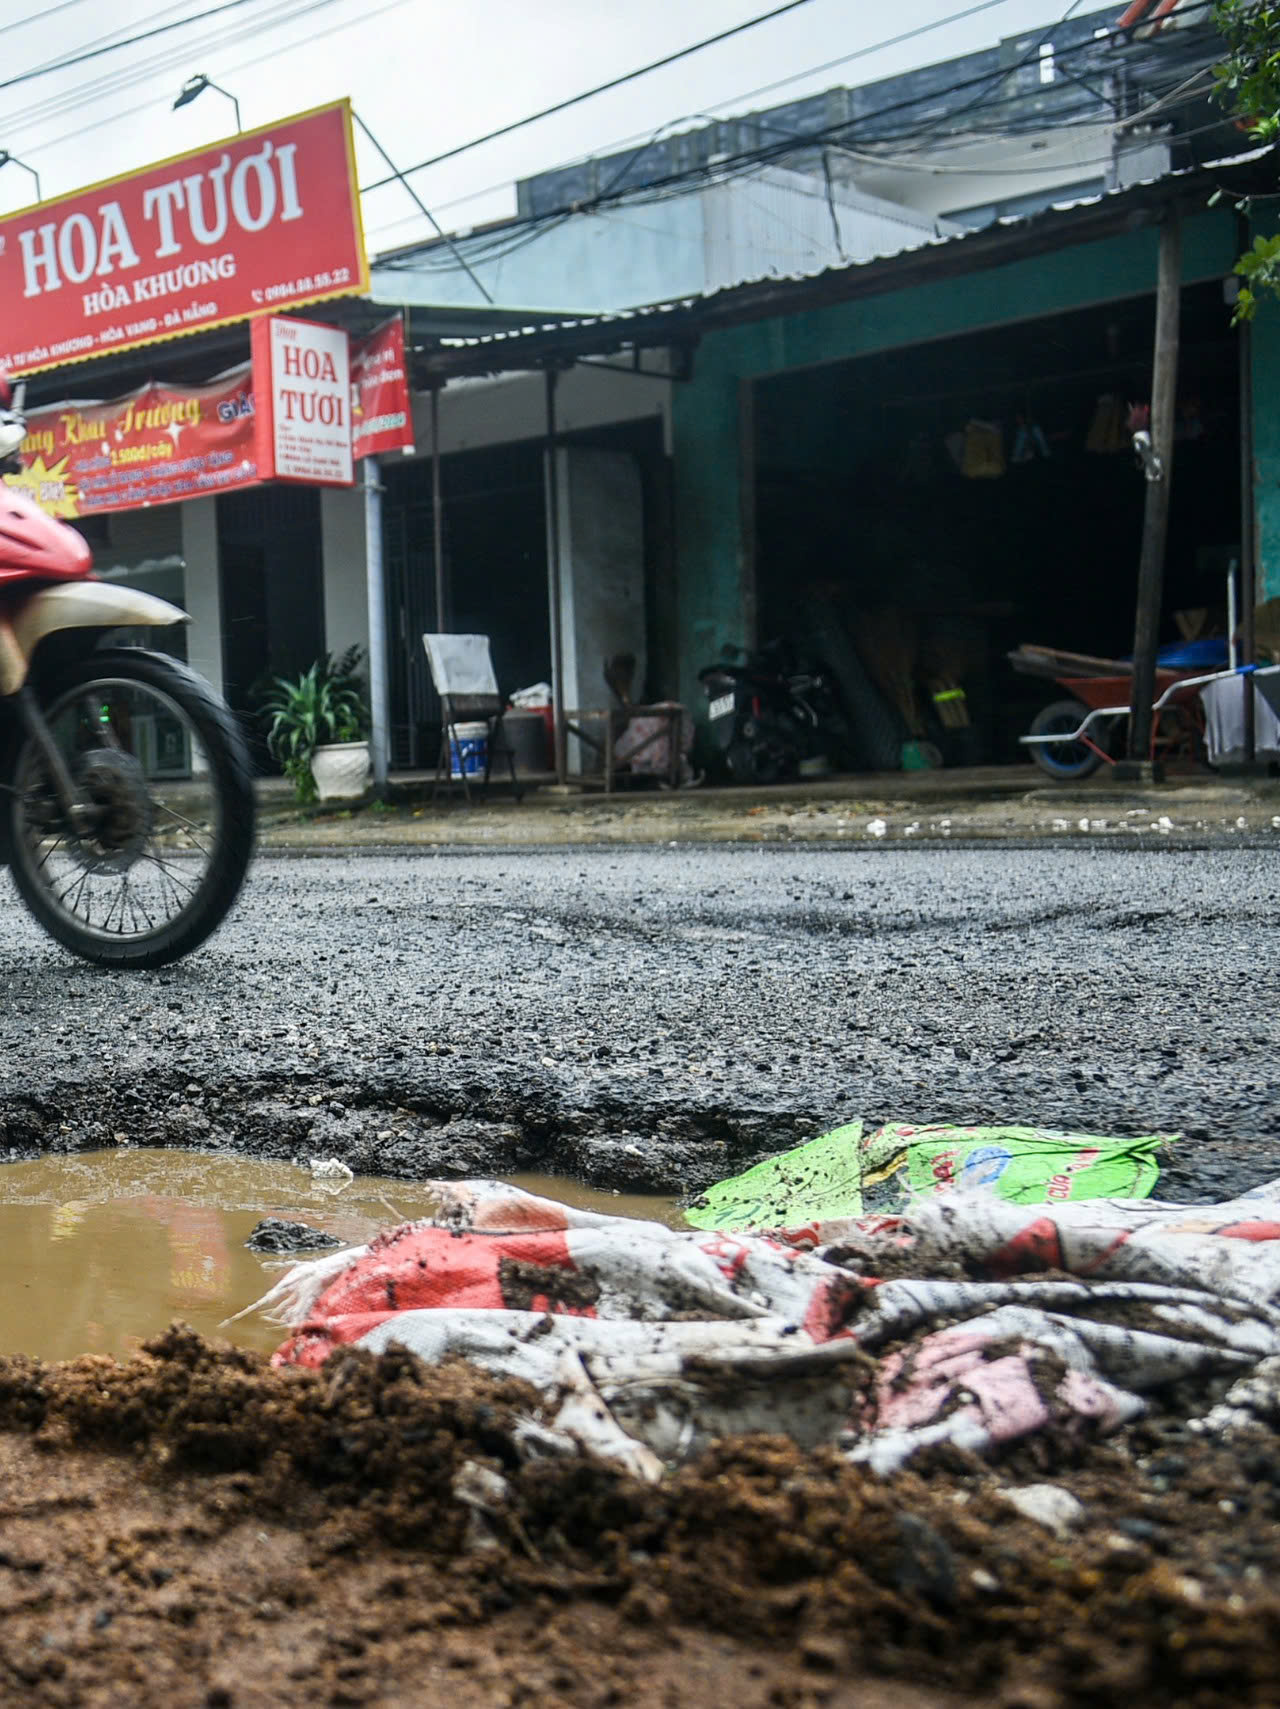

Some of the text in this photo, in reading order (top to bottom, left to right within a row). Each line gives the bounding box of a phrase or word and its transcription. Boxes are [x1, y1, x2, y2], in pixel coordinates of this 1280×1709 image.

[19, 140, 304, 297] HOA TƯƠI
[83, 254, 237, 316] HÒA KHƯƠNG
[282, 345, 338, 384] HOA
[216, 391, 256, 424] GIẢ
[280, 390, 345, 427] TƯƠI
